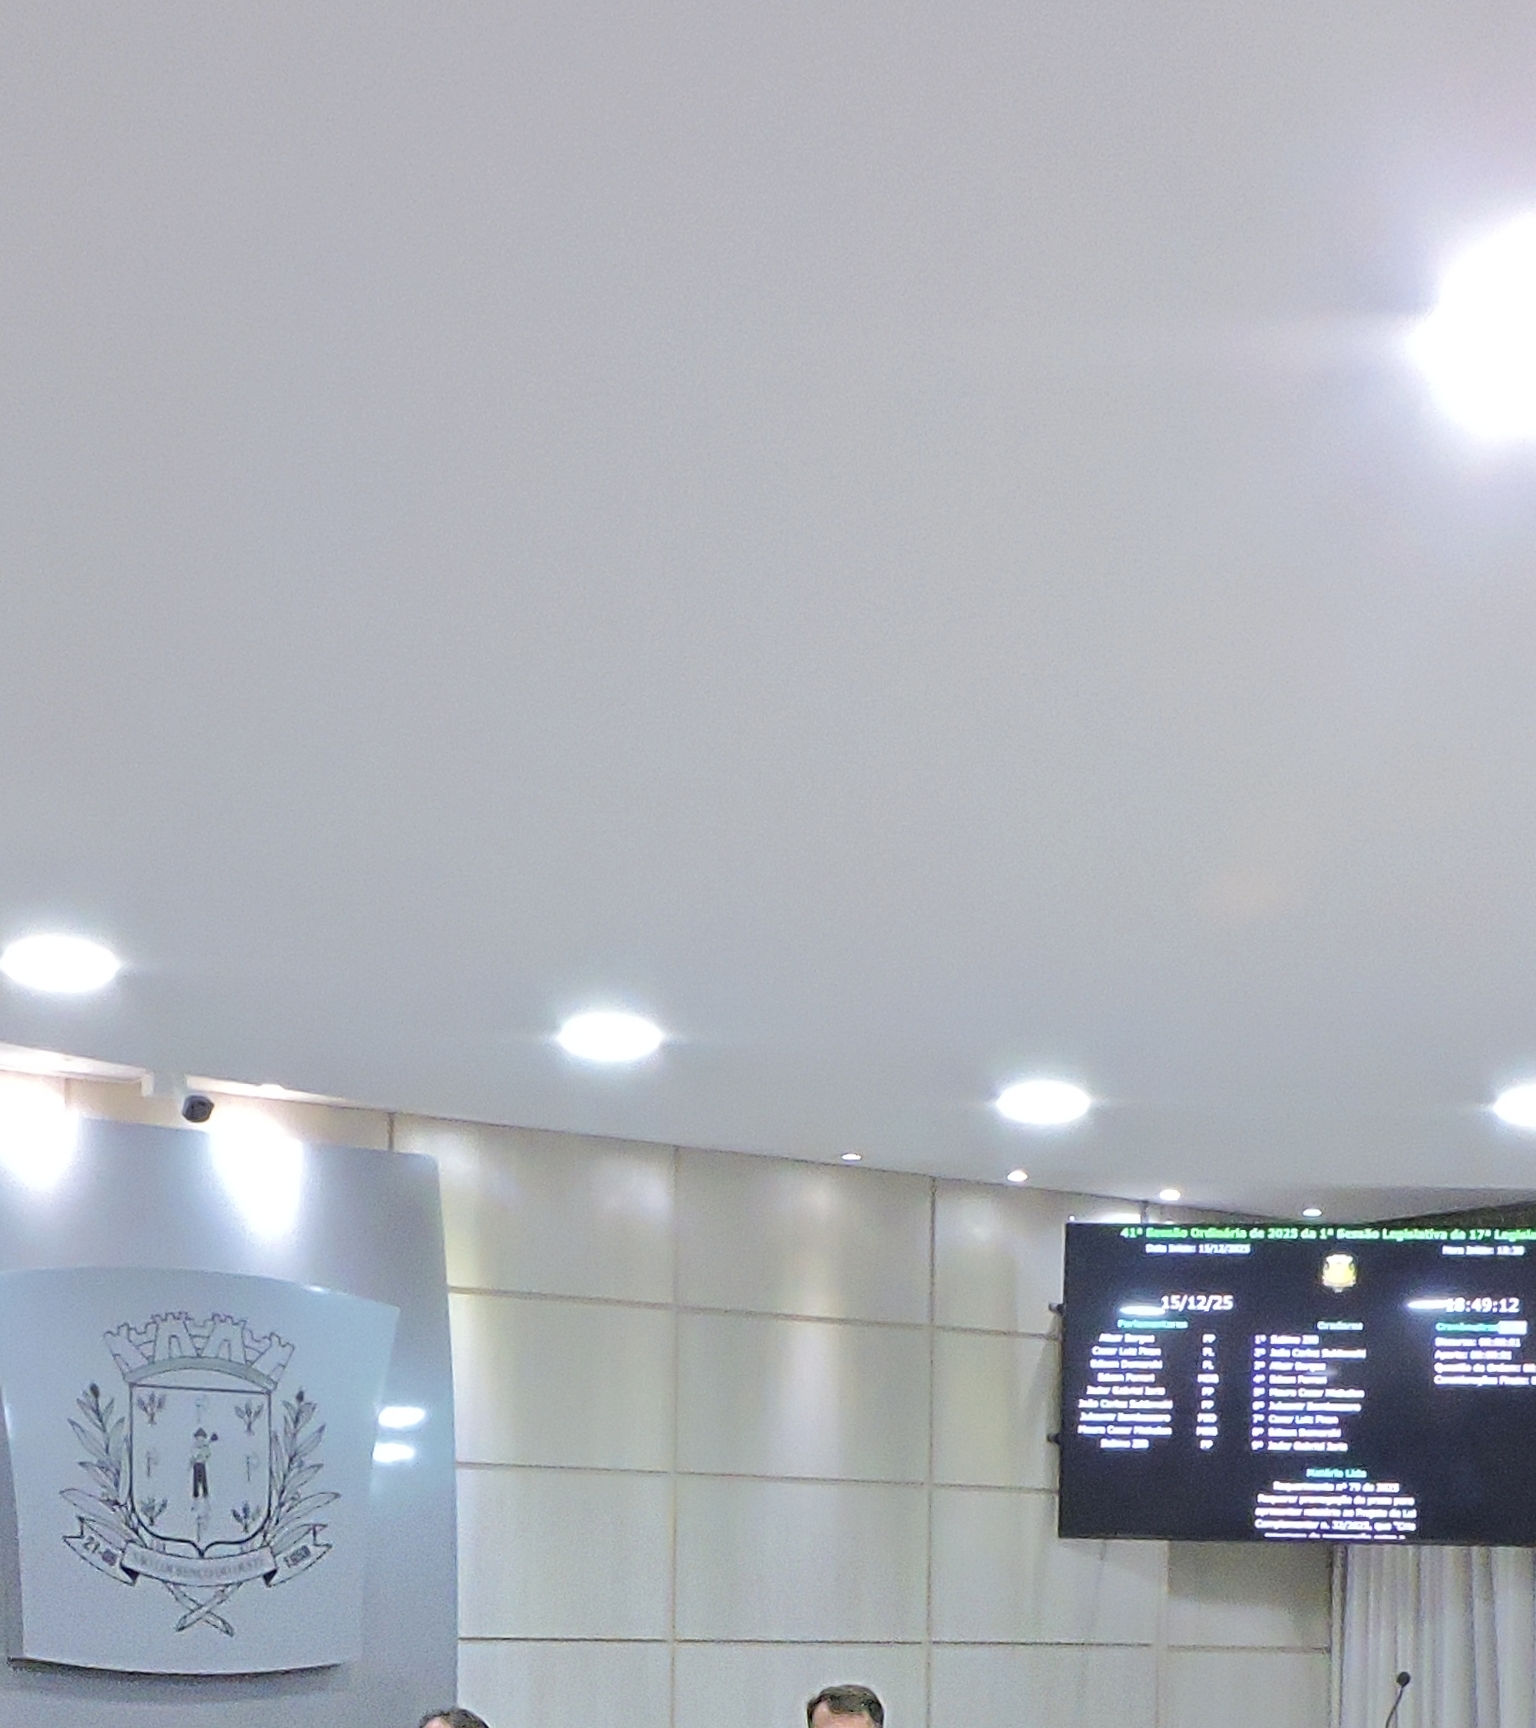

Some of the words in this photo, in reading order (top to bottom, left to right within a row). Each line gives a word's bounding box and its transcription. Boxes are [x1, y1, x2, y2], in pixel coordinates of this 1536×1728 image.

[1146, 1227, 1188, 1239] Sessão
[1190, 1227, 1247, 1239] Ordinária
[1268, 1228, 1298, 1239] 2025
[1336, 1228, 1379, 1240] Sessão
[1382, 1228, 1448, 1242] Legislativa
[1161, 1295, 1234, 1312] 15/12/25
